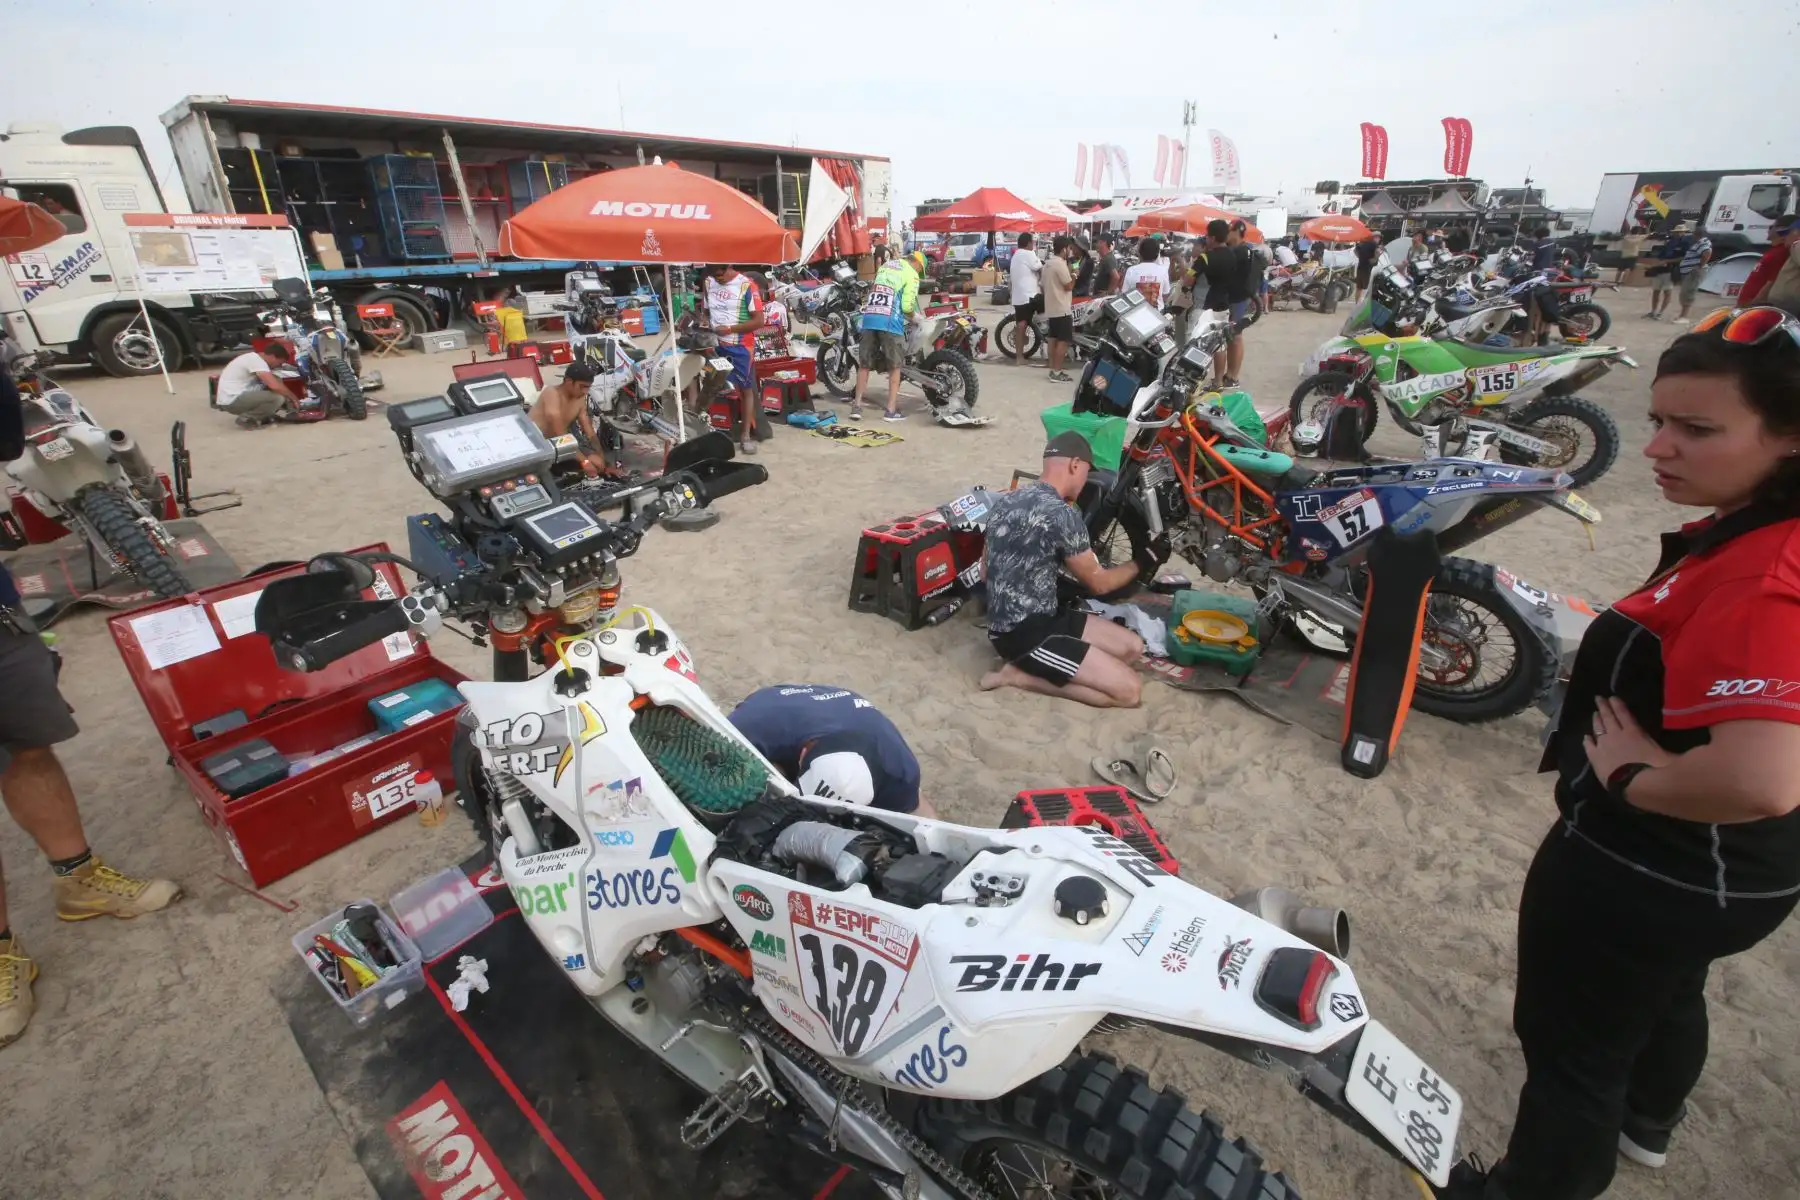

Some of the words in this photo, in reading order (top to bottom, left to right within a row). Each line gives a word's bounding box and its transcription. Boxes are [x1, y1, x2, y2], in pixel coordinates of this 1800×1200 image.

[590, 200, 711, 219] MOTUL
[21, 264, 44, 280] L2
[23, 241, 96, 303] ANESMAR
[54, 252, 102, 289] CARGAS
[867, 291, 889, 306] 121
[1482, 372, 1515, 393] 155
[1426, 481, 1484, 495] Zreclame
[1706, 678, 1800, 698] 300V
[475, 711, 544, 749] TO
[514, 855, 534, 869] Club
[534, 861, 567, 874] Perche
[586, 866, 681, 911] stores
[742, 895, 773, 915] ARTE
[816, 902, 880, 942] #EPIC
[880, 920, 914, 944] STORY
[886, 940, 908, 958] MOTUL
[949, 953, 1103, 993] Bihr
[799, 933, 887, 1057] 138
[396, 1099, 510, 1200] MOT
